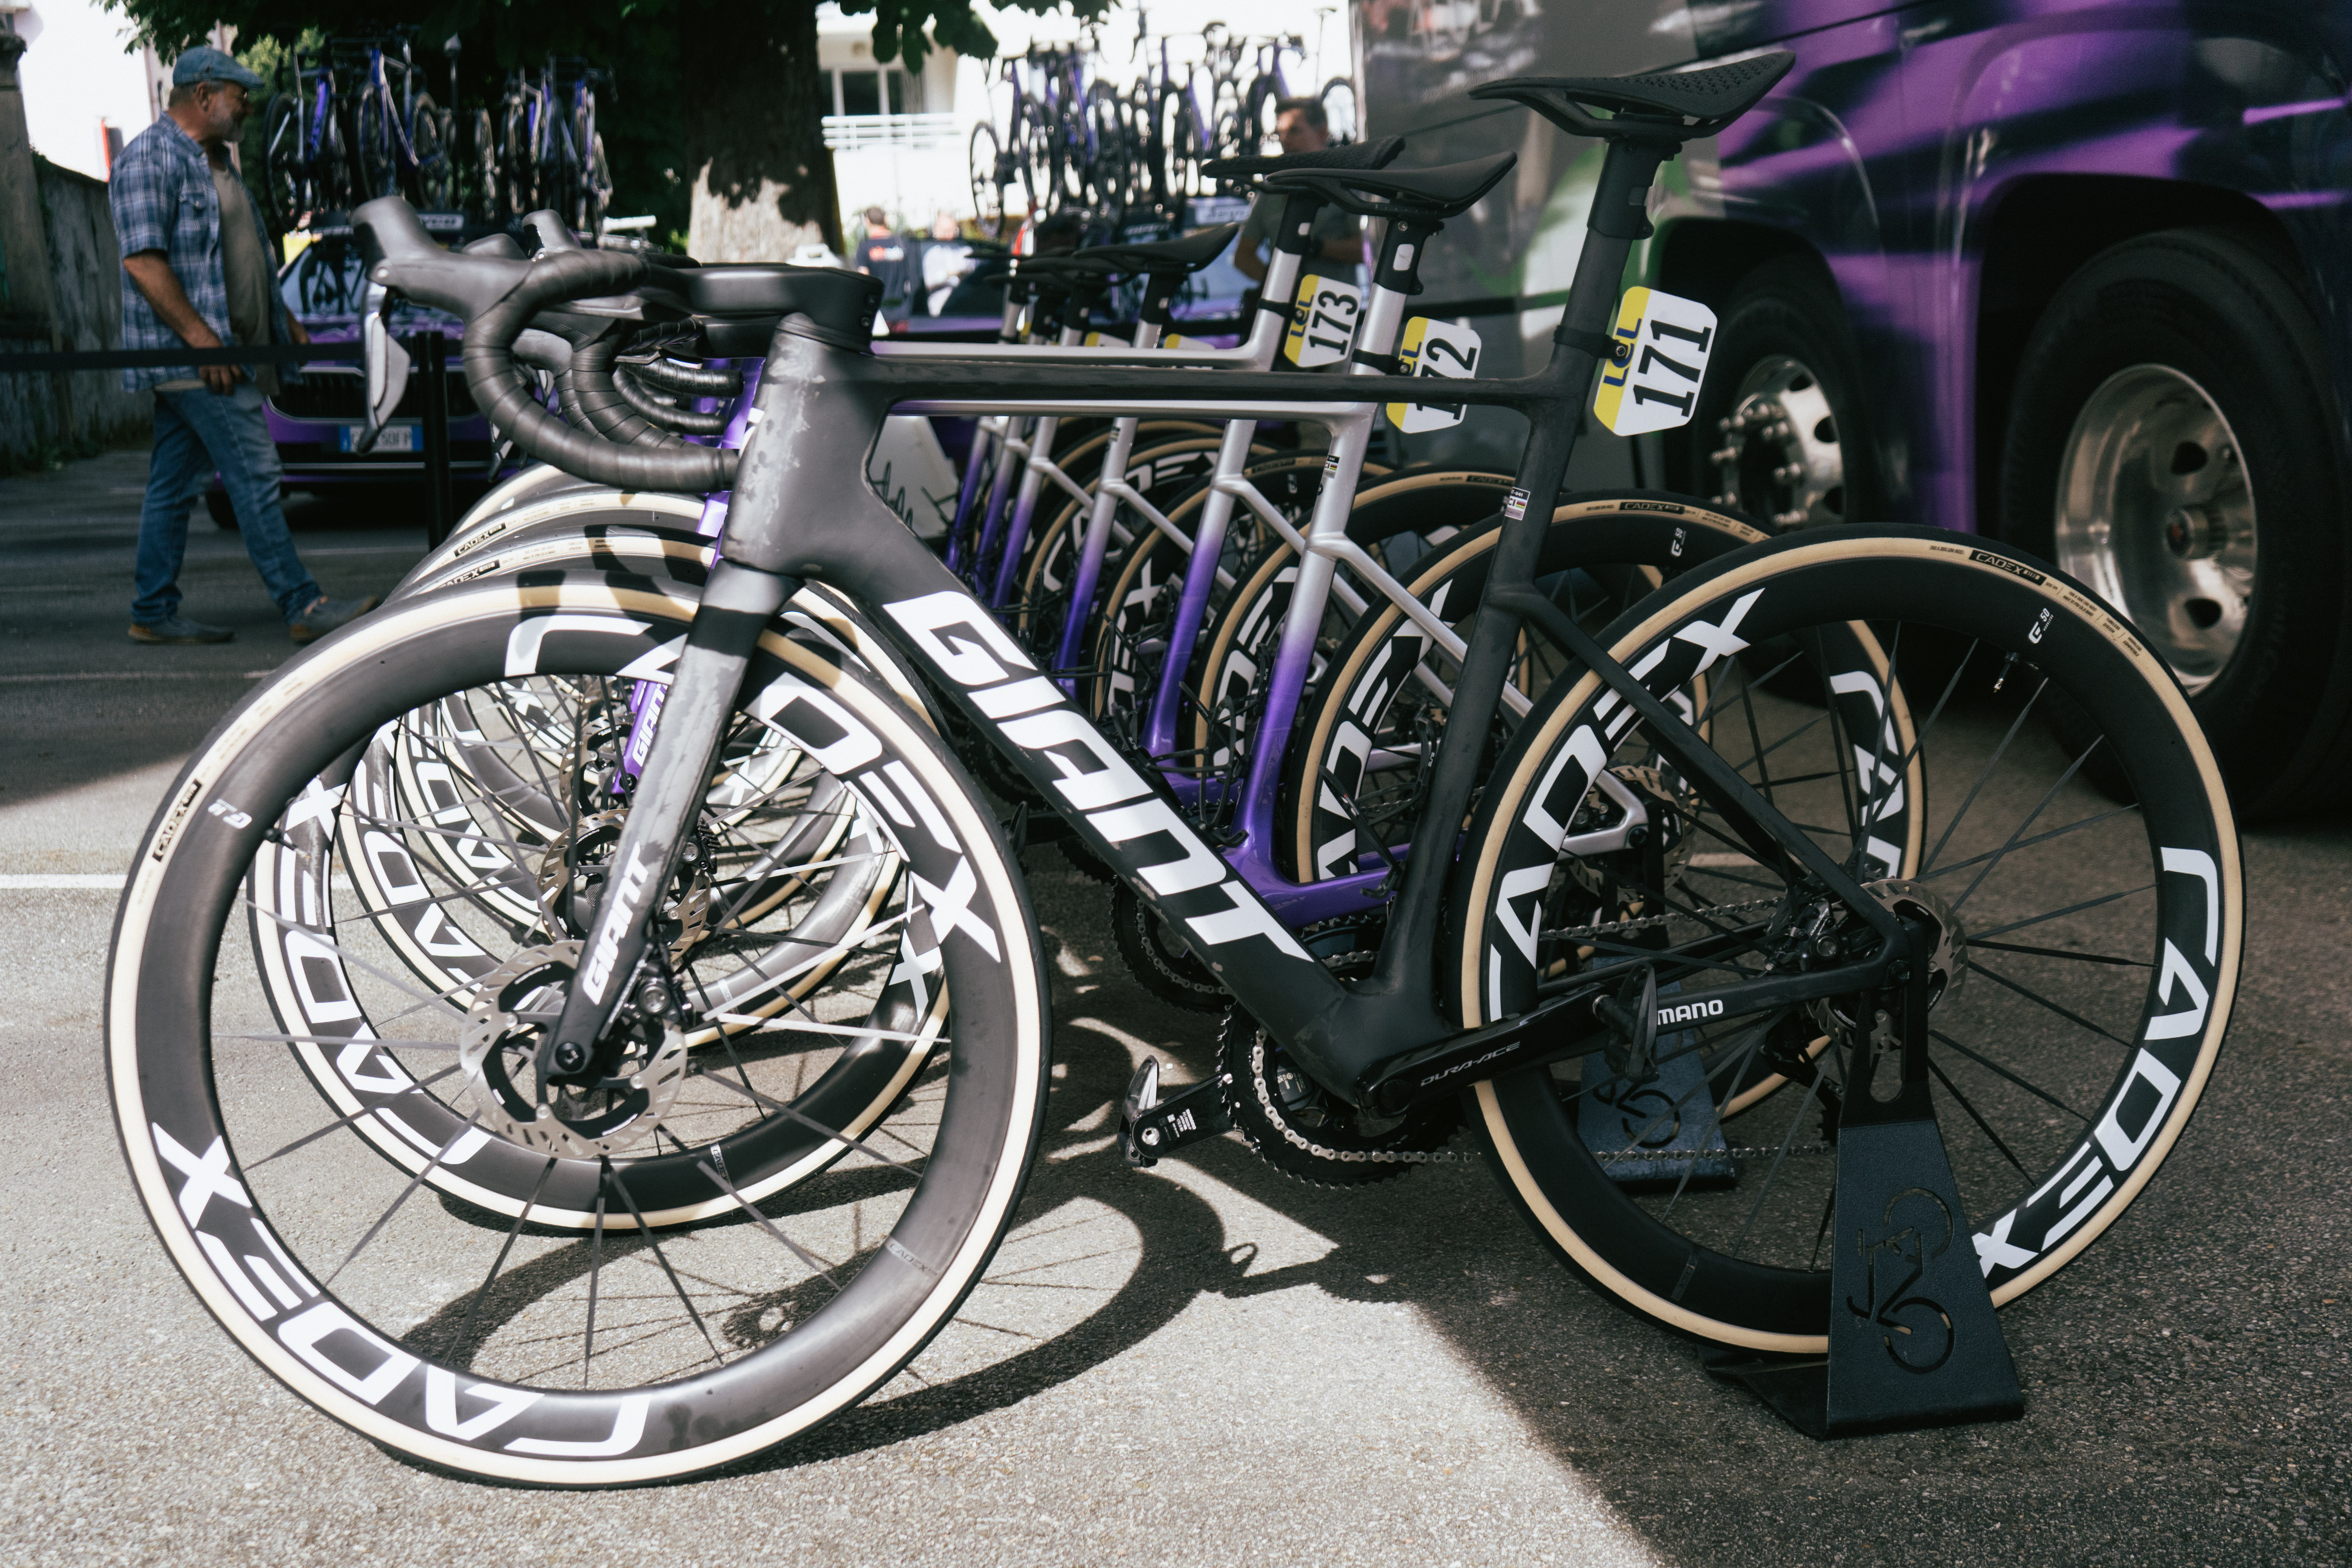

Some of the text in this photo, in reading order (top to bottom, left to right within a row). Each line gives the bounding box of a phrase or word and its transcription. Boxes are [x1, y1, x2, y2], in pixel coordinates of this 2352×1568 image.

[1309, 290, 1357, 355] 173
[1603, 318, 1642, 387] LCL
[1633, 319, 1712, 417] 171
[457, 530, 490, 555] CADEX
[1976, 553, 2022, 575] CADEX
[2040, 608, 2050, 622] 50
[2103, 623, 2115, 633] SYSTEM
[2106, 618, 2120, 630] TUBELESS
[2123, 641, 2140, 657] COMPATIBLE
[2128, 637, 2142, 651] HOOKLESS
[882, 591, 1315, 963] GIANT
[155, 802, 189, 856] CADEX
[583, 841, 649, 1005] GIANT
[1658, 999, 1723, 1025] MANO
[1421, 1041, 1520, 1087] DURA-ACE
[1971, 846, 2219, 1279] CADEX
[890, 1243, 928, 1272] CADEX
[153, 1122, 652, 1457] CADEX
